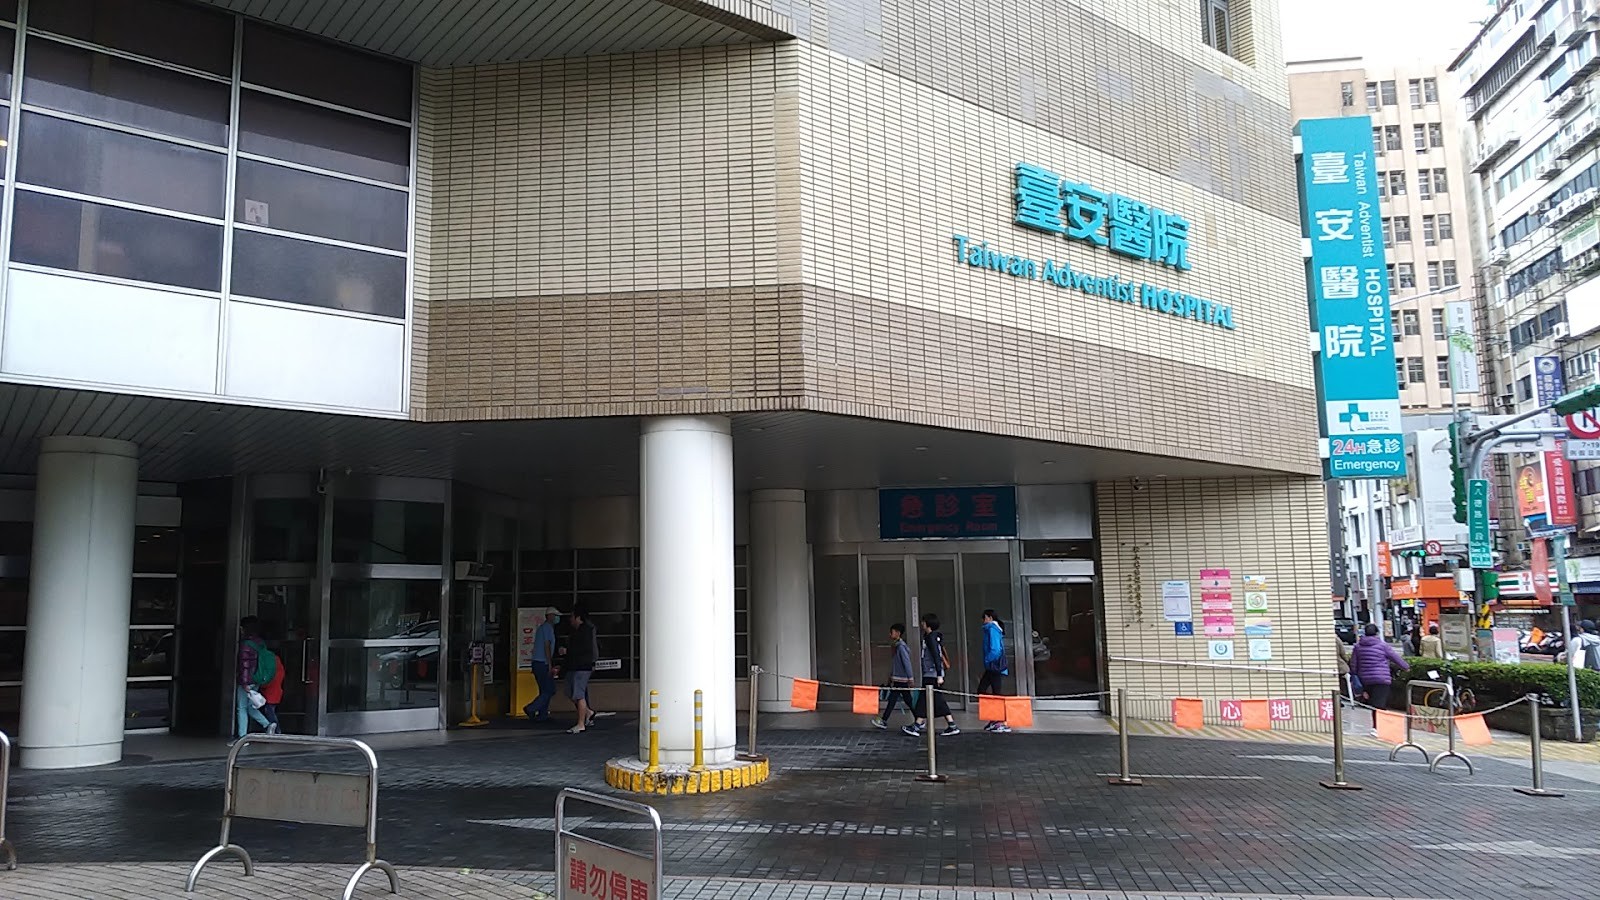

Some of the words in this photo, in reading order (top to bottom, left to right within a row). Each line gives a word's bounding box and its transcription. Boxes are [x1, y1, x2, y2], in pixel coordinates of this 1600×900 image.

[1353, 151, 1368, 195] Taiwan
[1014, 161, 1192, 272] 臺安醫院
[1358, 201, 1375, 258] Adventist
[953, 235, 1036, 282] Taiwan
[1043, 259, 1138, 305] Adventist
[1140, 283, 1237, 330] HOSPITAL
[1311, 151, 1366, 359] 臺安醫院
[1365, 268, 1388, 357] HOSPITAL
[1333, 438, 1400, 456] 24H急診
[1334, 460, 1400, 472] Emergency
[900, 493, 998, 519] 急診室
[1473, 488, 1484, 541] 八德路二段
